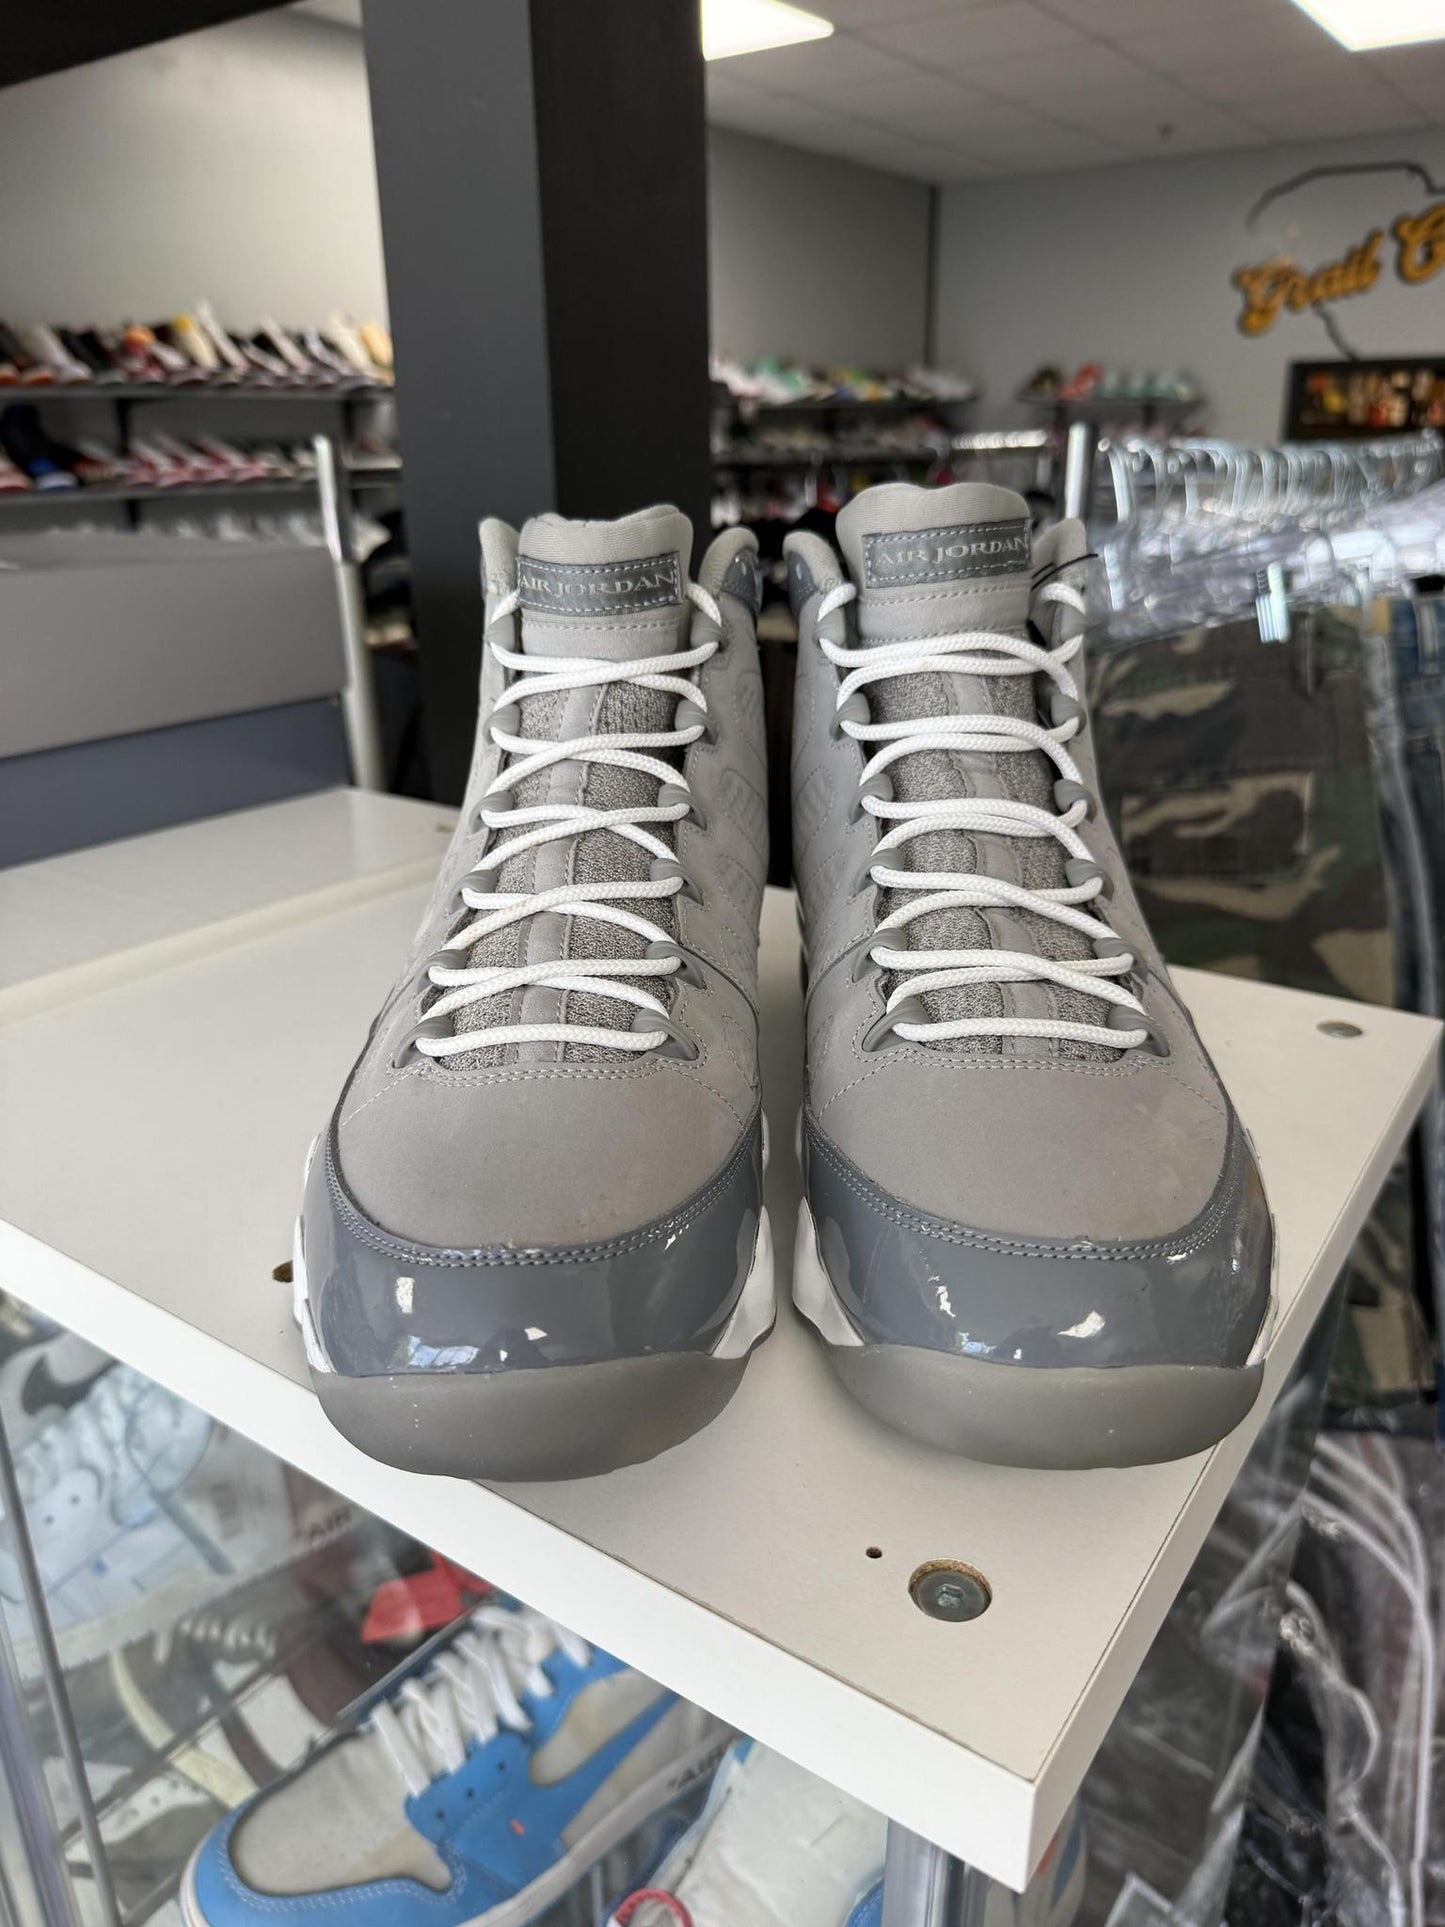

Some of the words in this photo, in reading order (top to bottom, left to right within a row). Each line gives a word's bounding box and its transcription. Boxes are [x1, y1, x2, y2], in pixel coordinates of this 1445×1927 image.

[874, 549, 929, 567] AIR
[932, 537, 1029, 565] JORDAN
[519, 575, 552, 593] AIR
[554, 571, 676, 598] JORDAN
